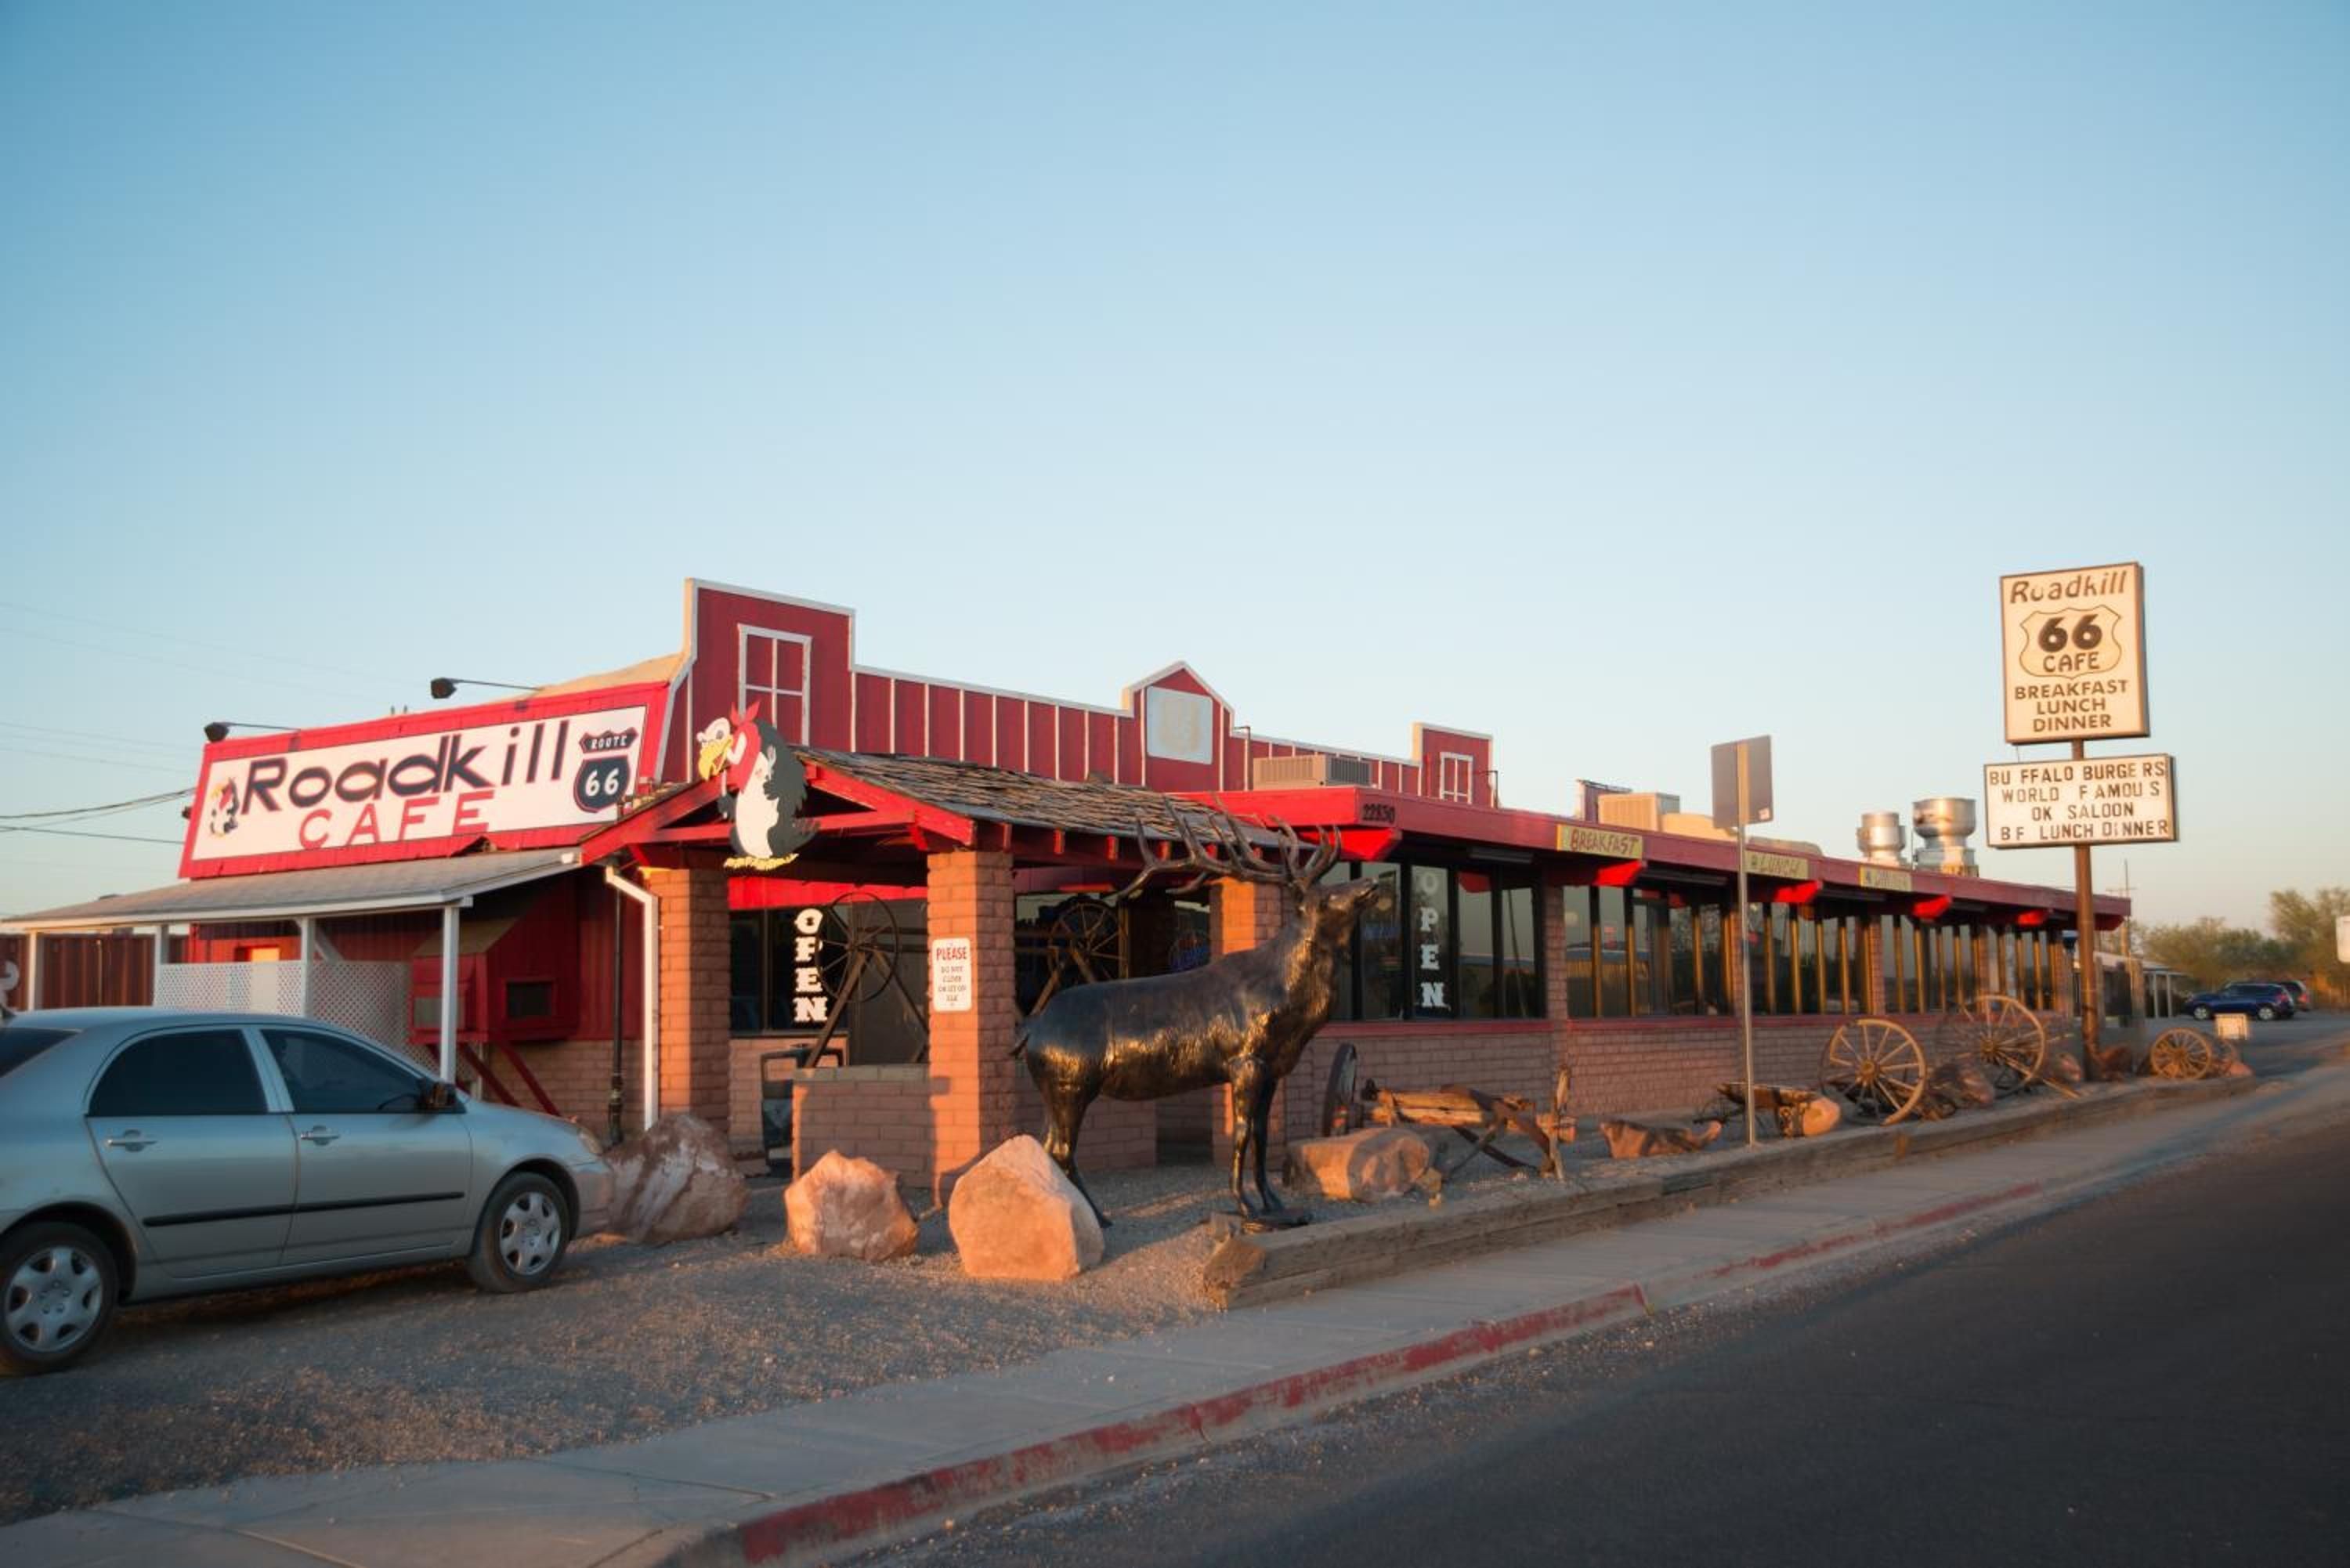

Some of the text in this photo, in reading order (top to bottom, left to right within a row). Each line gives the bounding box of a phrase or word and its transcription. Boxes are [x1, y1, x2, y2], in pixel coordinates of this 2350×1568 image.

[2010, 570, 2127, 604] Roadkill
[2037, 614, 2102, 652] 66
[2043, 652, 2100, 673] CAFE
[2015, 679, 2128, 699] BREAKFAST
[2037, 698, 2106, 714] LUNCH
[2033, 714, 2112, 732] DINNER
[591, 735, 627, 750] ROUTE
[240, 719, 570, 815] Roadkill
[585, 768, 619, 797] 66
[2001, 786, 2059, 803] WORLD
[298, 789, 495, 849] CAFE
[2031, 801, 2134, 822] OK SALOON
[1570, 829, 1639, 854] BREAKFAST
[2039, 823, 2094, 840] LUNCH
[1420, 872, 1446, 1009] OPEN
[936, 946, 967, 961] PLEASE
[793, 908, 828, 1023] OPEN
